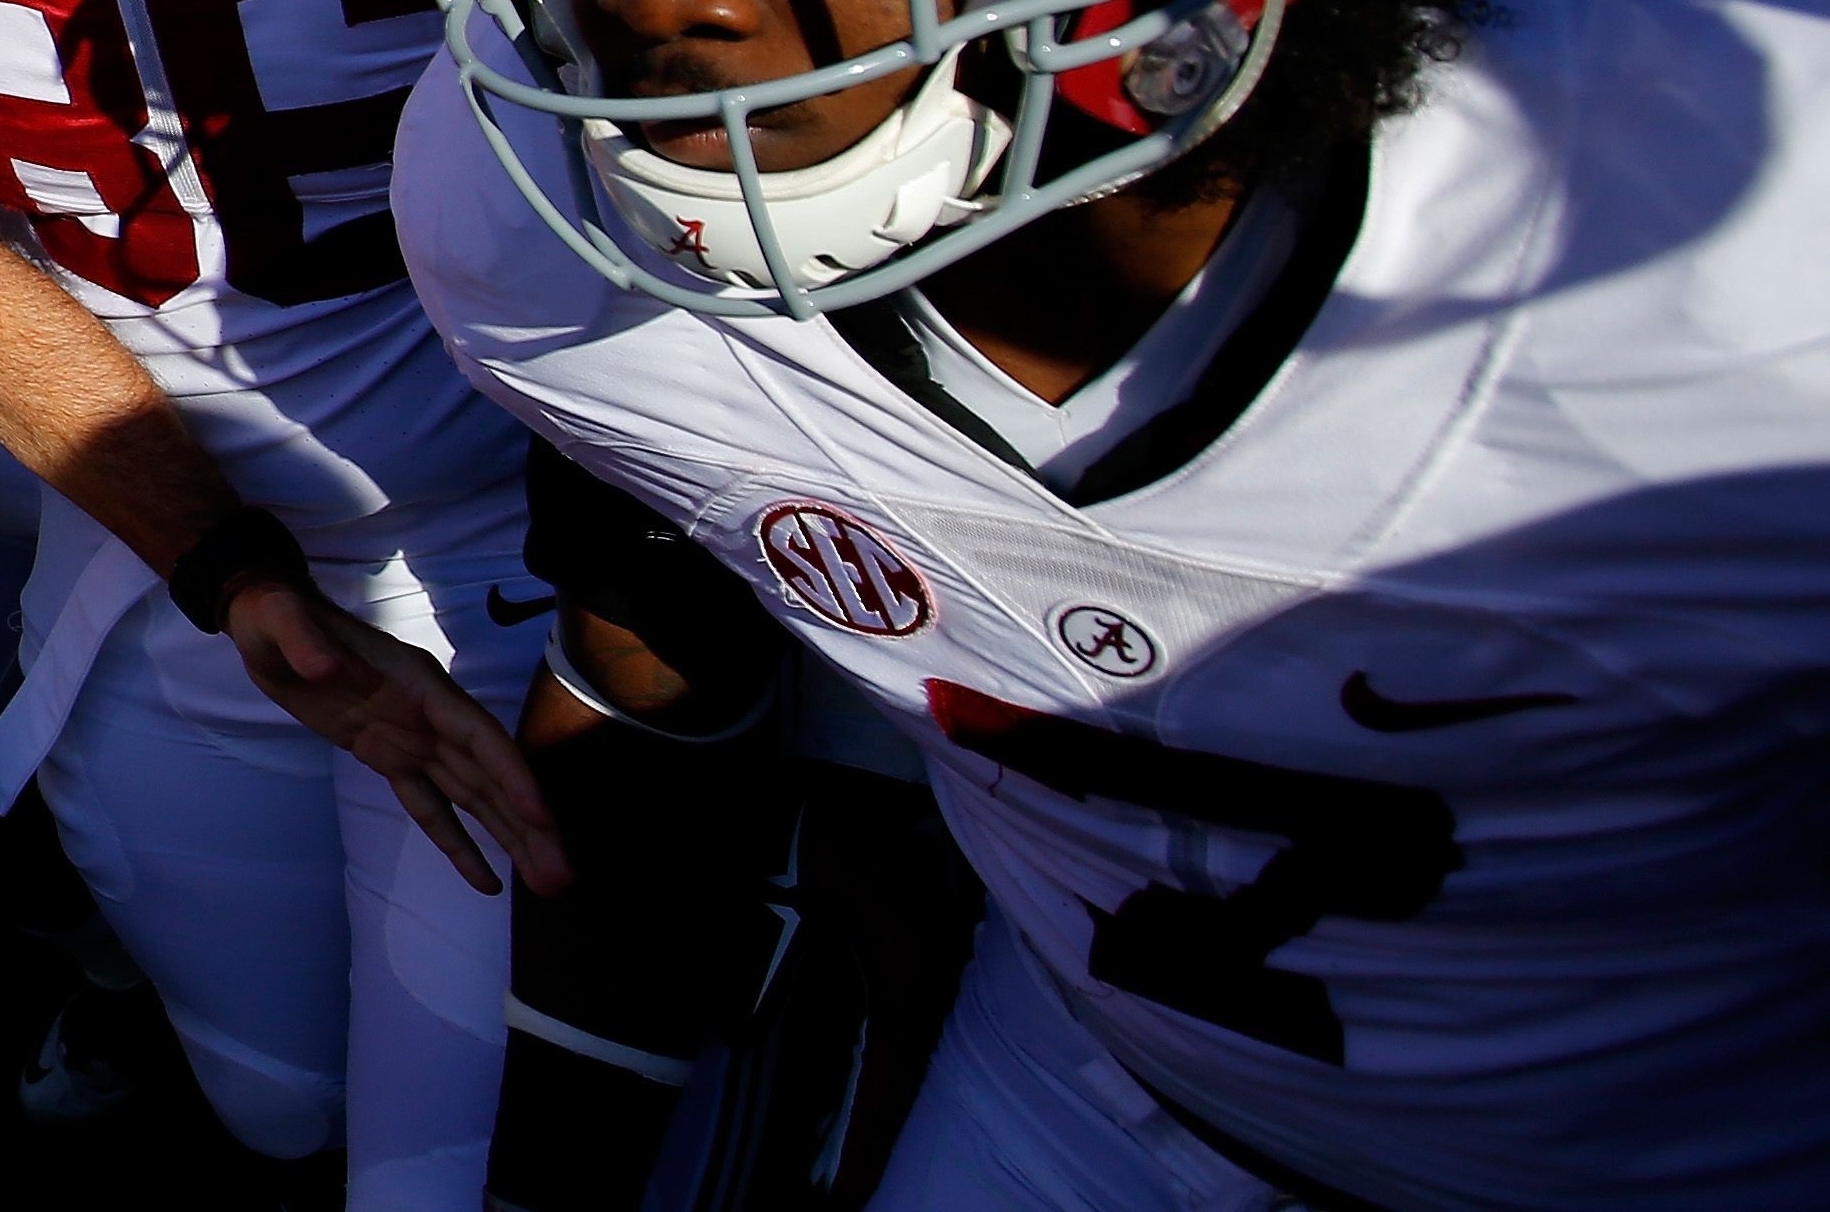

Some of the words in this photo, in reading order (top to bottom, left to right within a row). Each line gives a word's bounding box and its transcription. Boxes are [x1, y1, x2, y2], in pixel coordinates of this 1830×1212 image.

[658, 214, 719, 270] A
[763, 504, 932, 634] SEC
[1074, 613, 1140, 667] A
